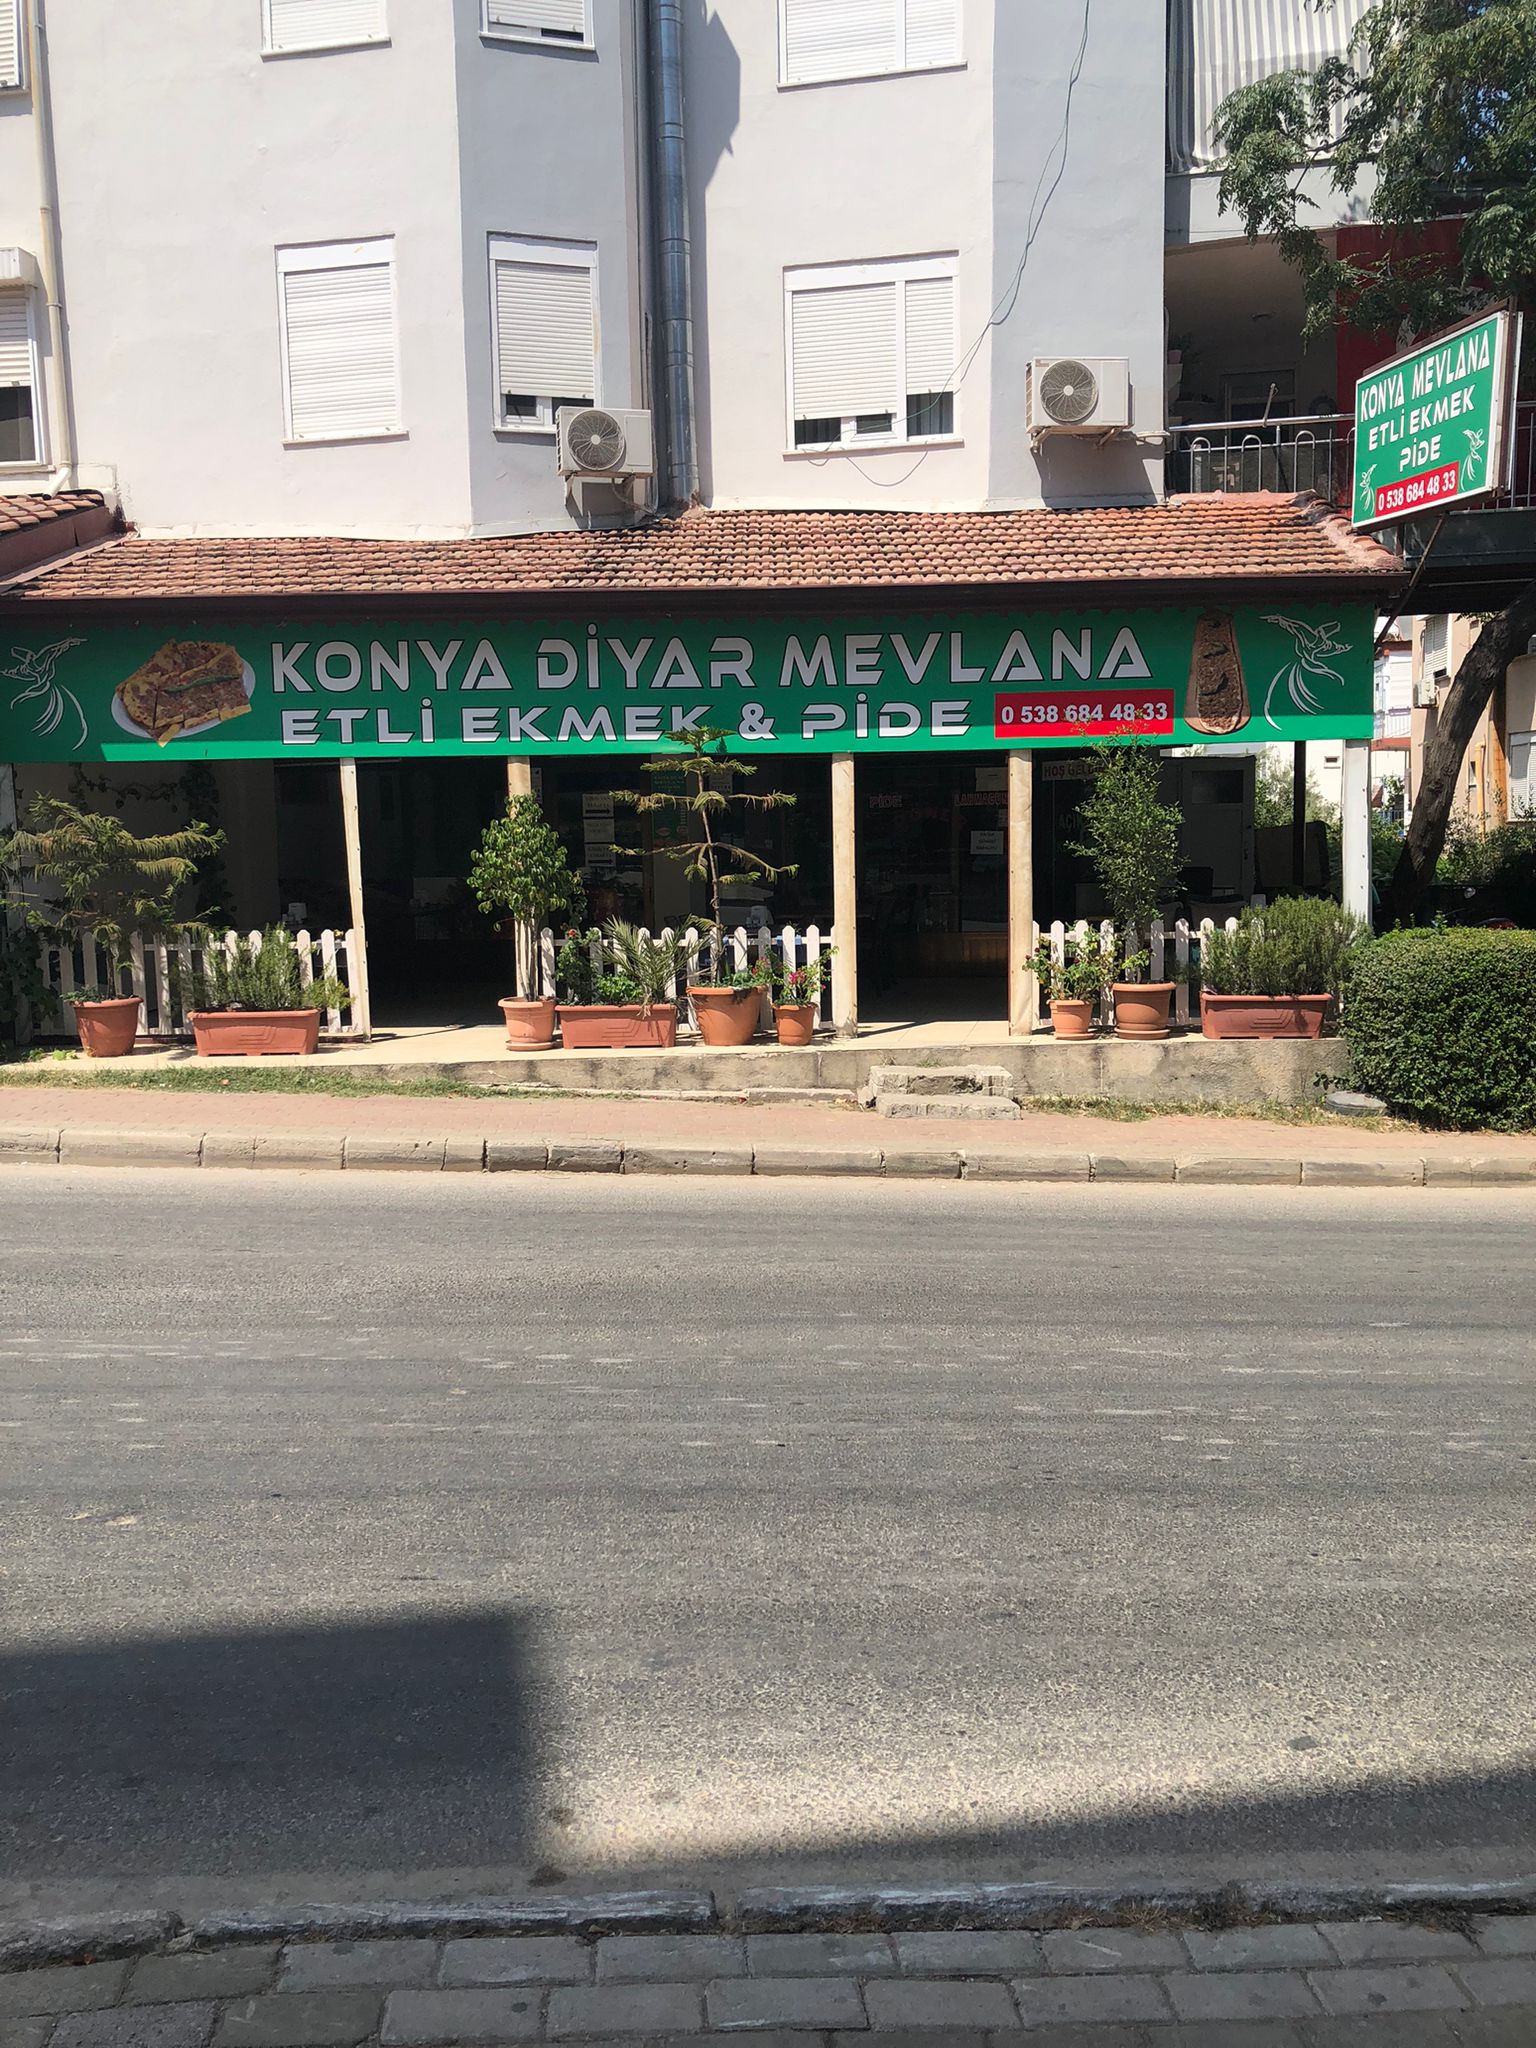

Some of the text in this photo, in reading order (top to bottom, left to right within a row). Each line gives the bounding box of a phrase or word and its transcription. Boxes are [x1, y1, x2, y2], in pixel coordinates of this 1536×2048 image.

[1360, 329, 1490, 423] KONYA MEVLANA
[1368, 384, 1476, 451] ETLİ EKMEK
[1399, 434, 1442, 472] PİDE
[1378, 469, 1456, 511] 0 538 684 48 33
[271, 623, 1153, 693] KONYA DİYAR MEVLANA
[281, 692, 972, 744] ETLİ EKMEK & PİDE
[1002, 702, 1168, 724] 0 538 684 48 33
